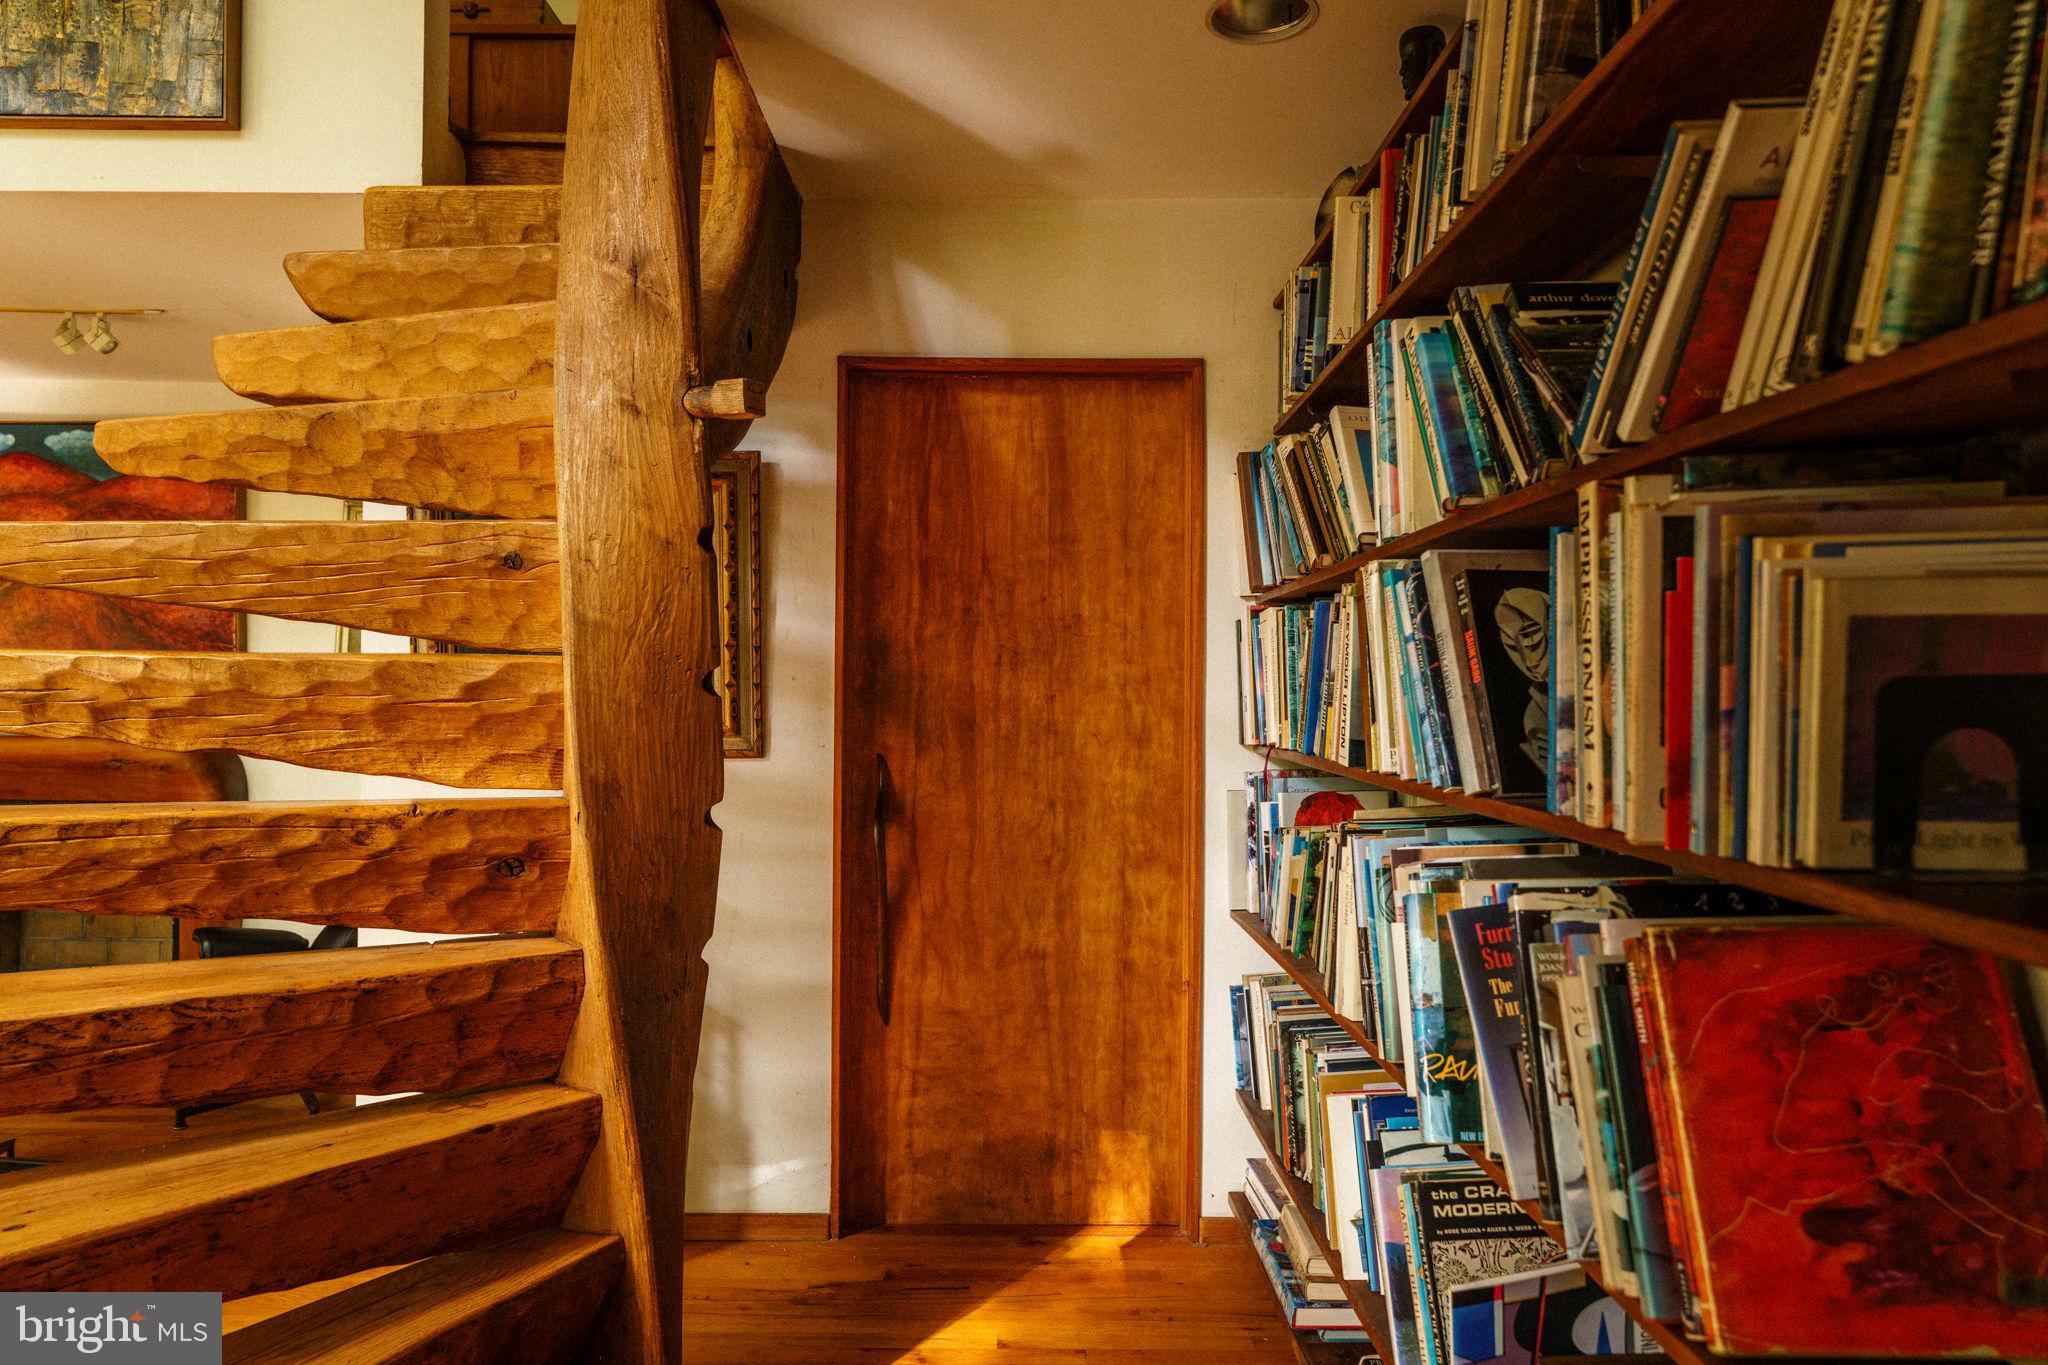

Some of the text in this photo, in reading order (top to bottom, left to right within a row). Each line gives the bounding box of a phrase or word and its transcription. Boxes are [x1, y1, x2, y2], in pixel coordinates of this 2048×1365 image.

[1626, 214, 1651, 272] Joan
[1528, 293, 1574, 303] arthur
[1592, 279, 1632, 382] Mitchell
[1343, 612, 1351, 689] SEYMOUR
[1580, 498, 1597, 752] IMPRESSIONISM
[1464, 629, 1482, 684] NAUM GABO
[1340, 694, 1349, 748] LIPTON
[1488, 978, 1513, 995] The
[1635, 1006, 1648, 1044] SMITH
[1460, 1131, 1476, 1141] NEW
[1431, 1189, 1459, 1200] the
[1433, 1202, 1527, 1218] MODERN
[1400, 1199, 1413, 1265] GASTON
